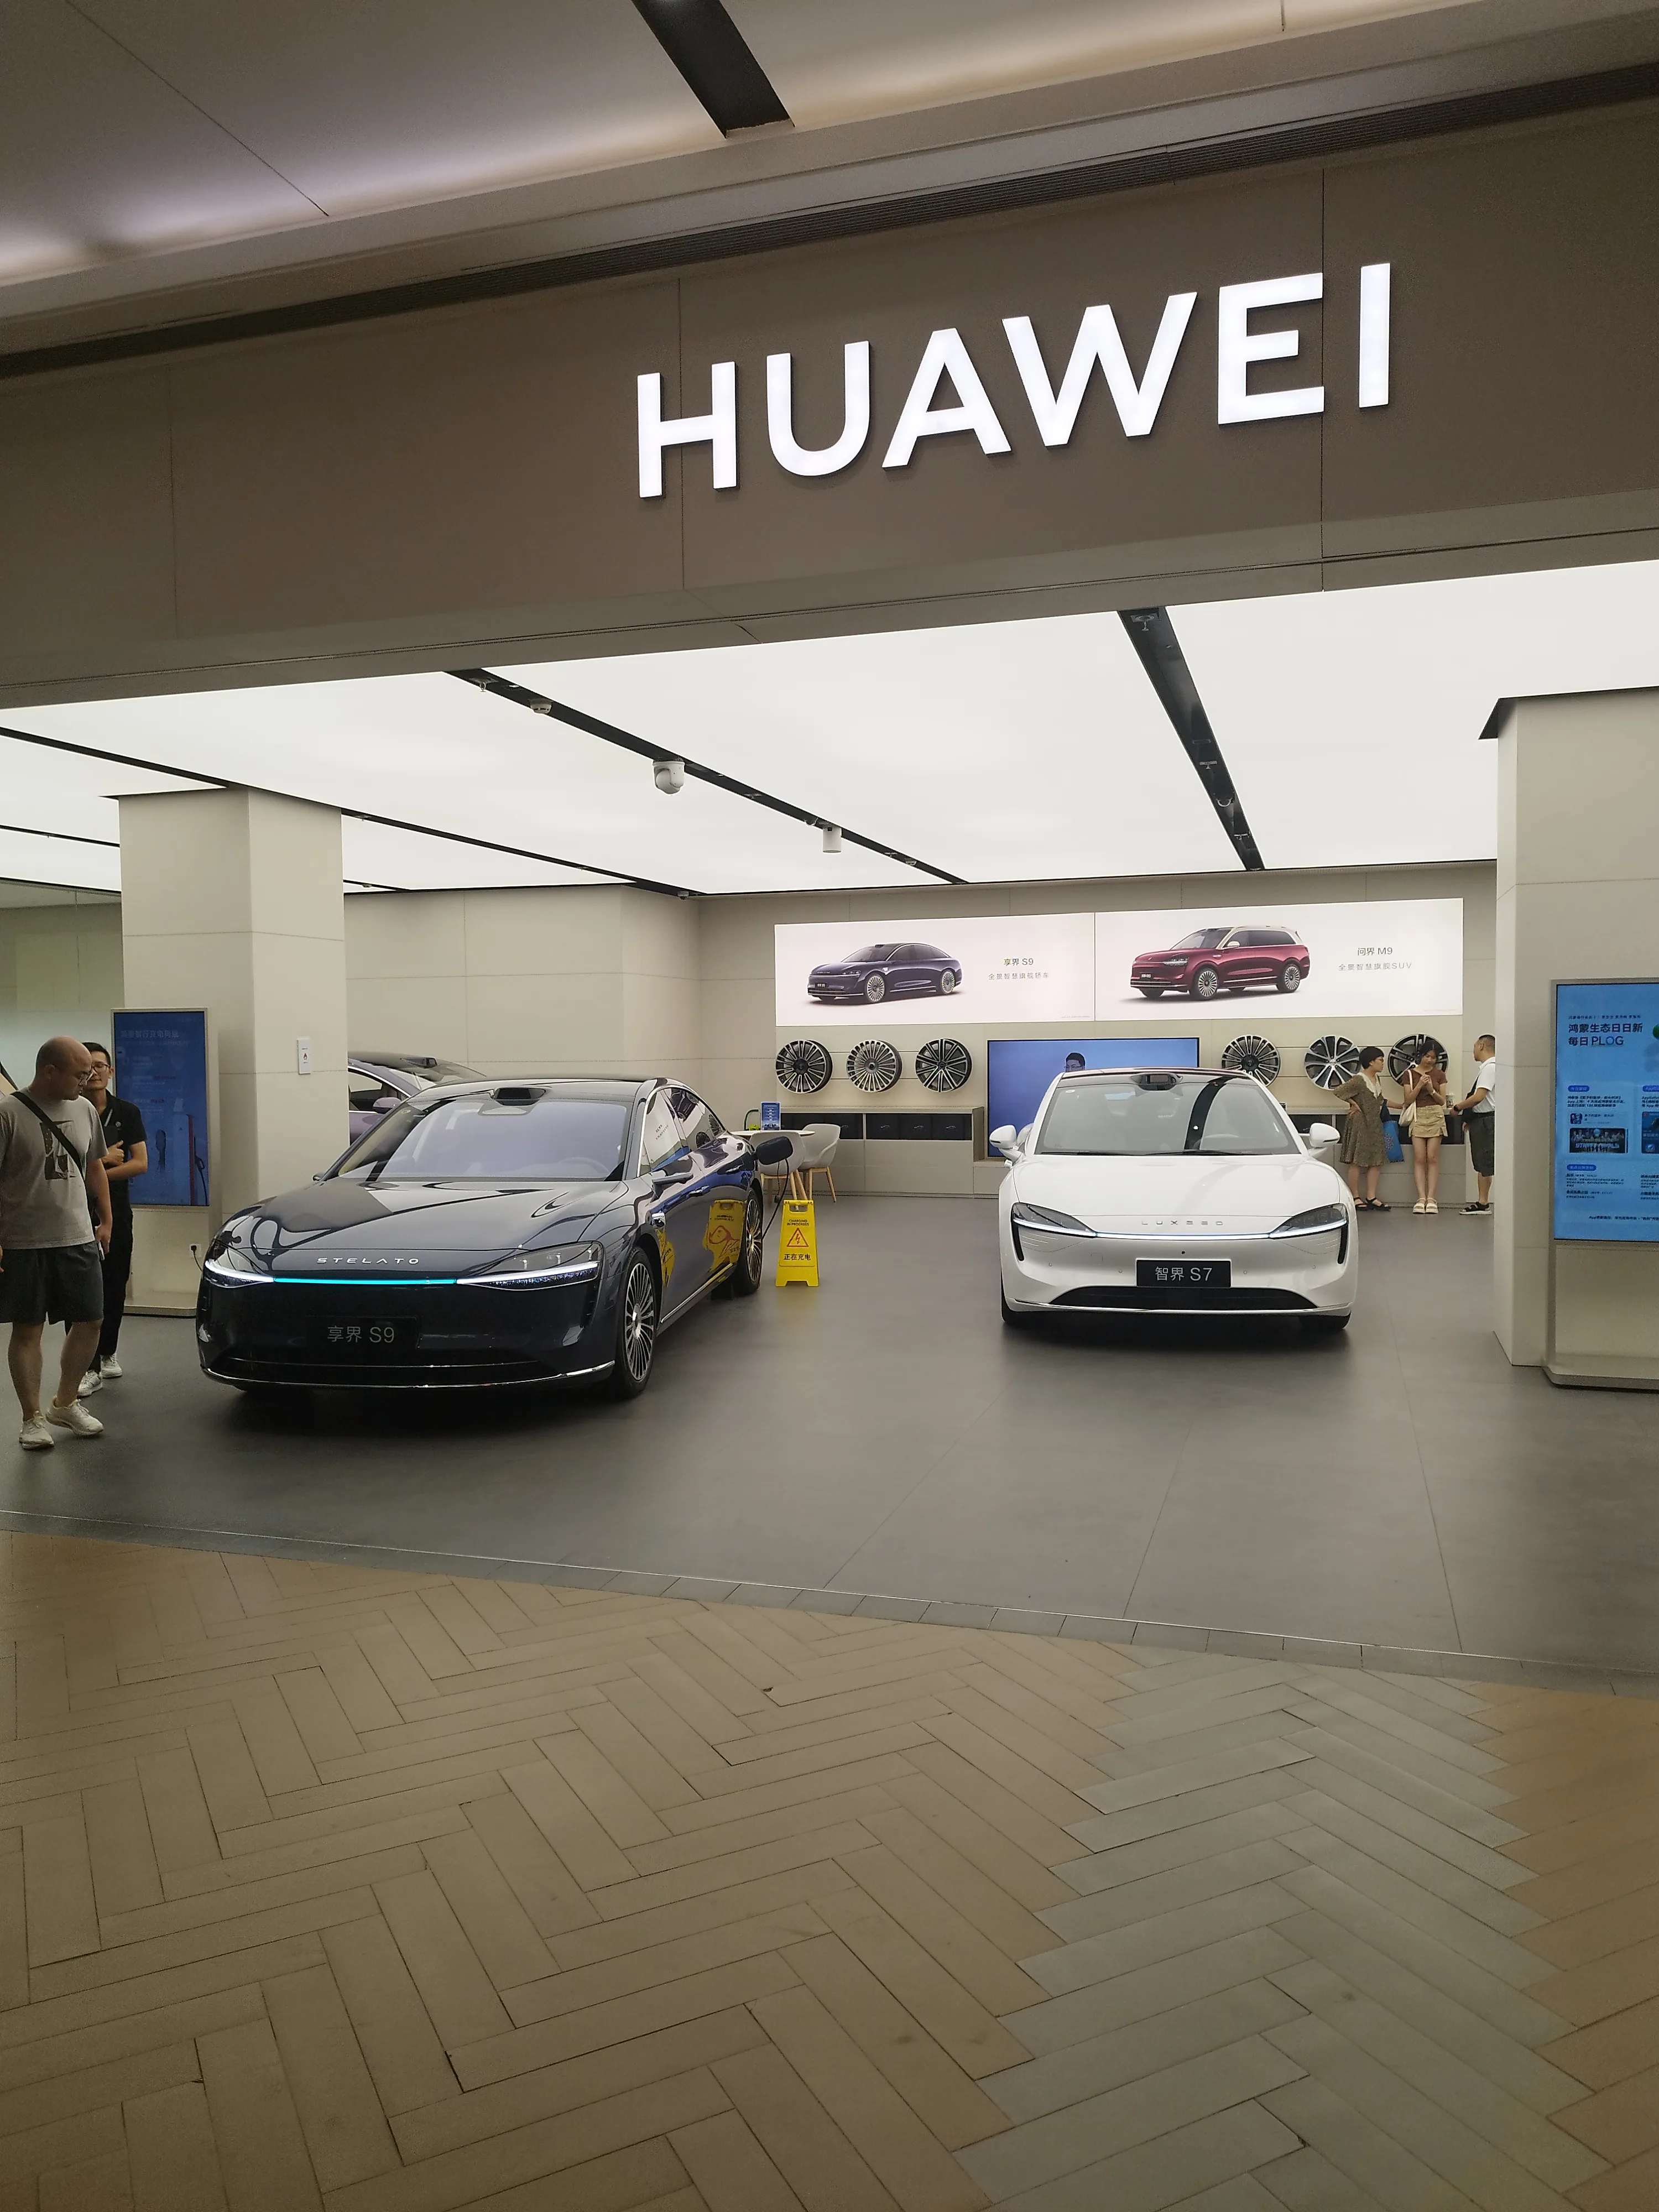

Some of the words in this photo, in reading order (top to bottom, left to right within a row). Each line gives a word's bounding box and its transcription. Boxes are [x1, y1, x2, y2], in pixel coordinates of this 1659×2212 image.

[638, 263, 1391, 498] HUAWEI
[1357, 947, 1375, 956] 问界
[1378, 947, 1393, 955] M9
[1339, 962, 1412, 971] 全景智慧旗舰SUV
[1568, 1023, 1643, 1033] 鸿蒙生态日日新
[1155, 1266, 1185, 1281] 智界
[1190, 1267, 1212, 1281] S7
[327, 1326, 362, 1342] 享界
[369, 1327, 394, 1343] S9
